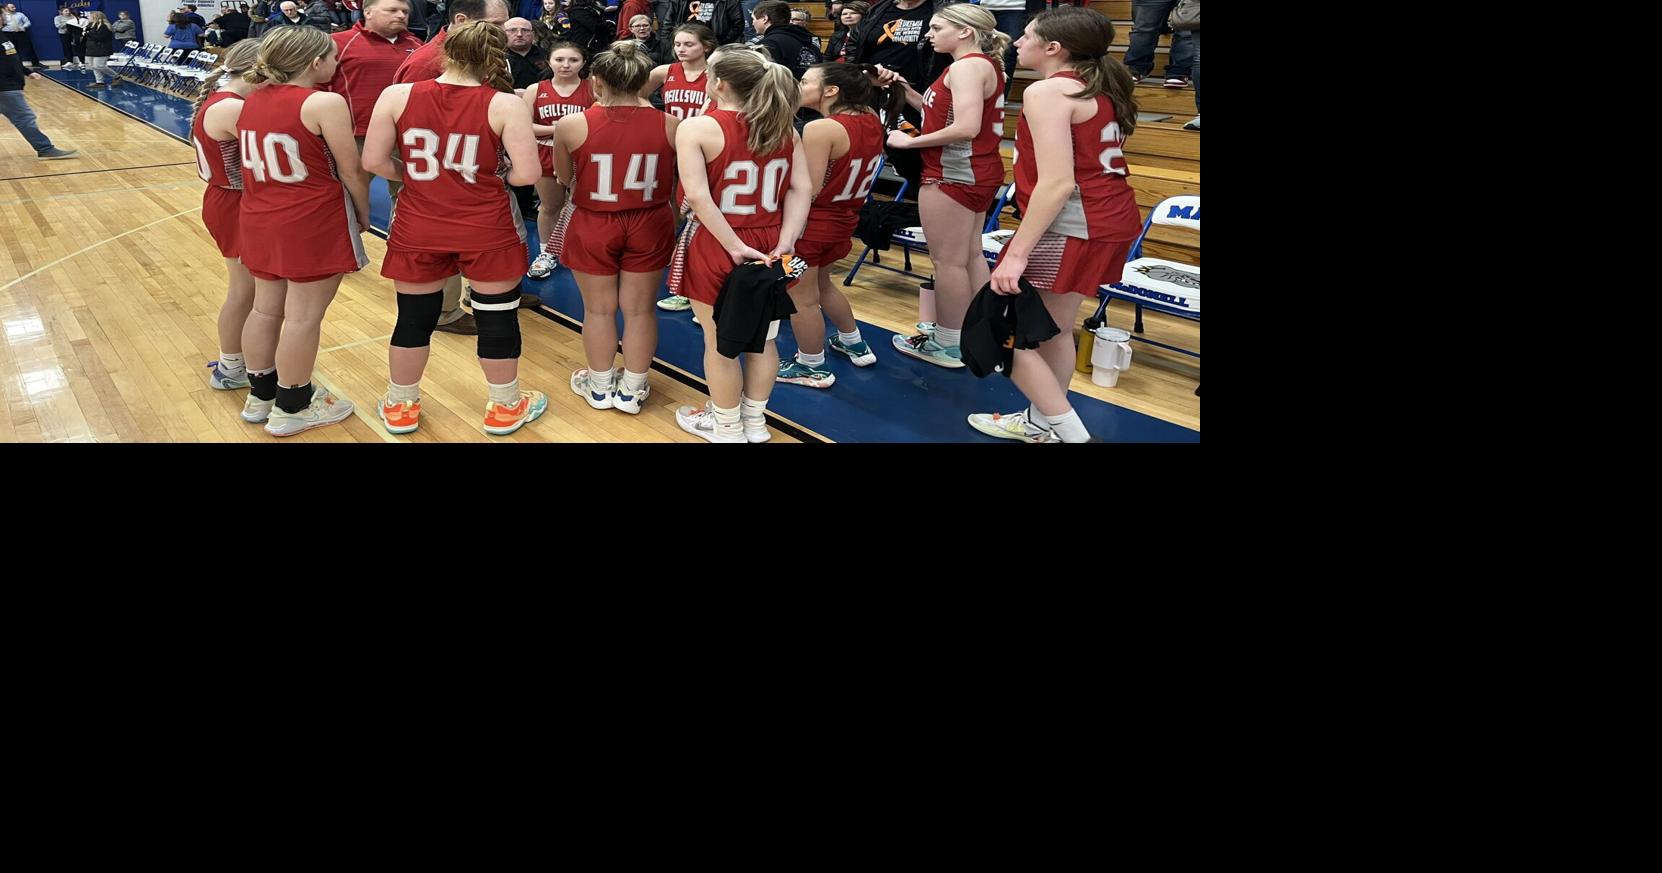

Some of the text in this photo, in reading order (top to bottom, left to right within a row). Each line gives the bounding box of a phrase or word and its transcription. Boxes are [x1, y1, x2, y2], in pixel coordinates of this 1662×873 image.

[241, 129, 309, 183] 40
[402, 128, 480, 184] 34
[590, 153, 659, 202] 14
[831, 154, 880, 202] 12
[720, 157, 789, 216] 20
